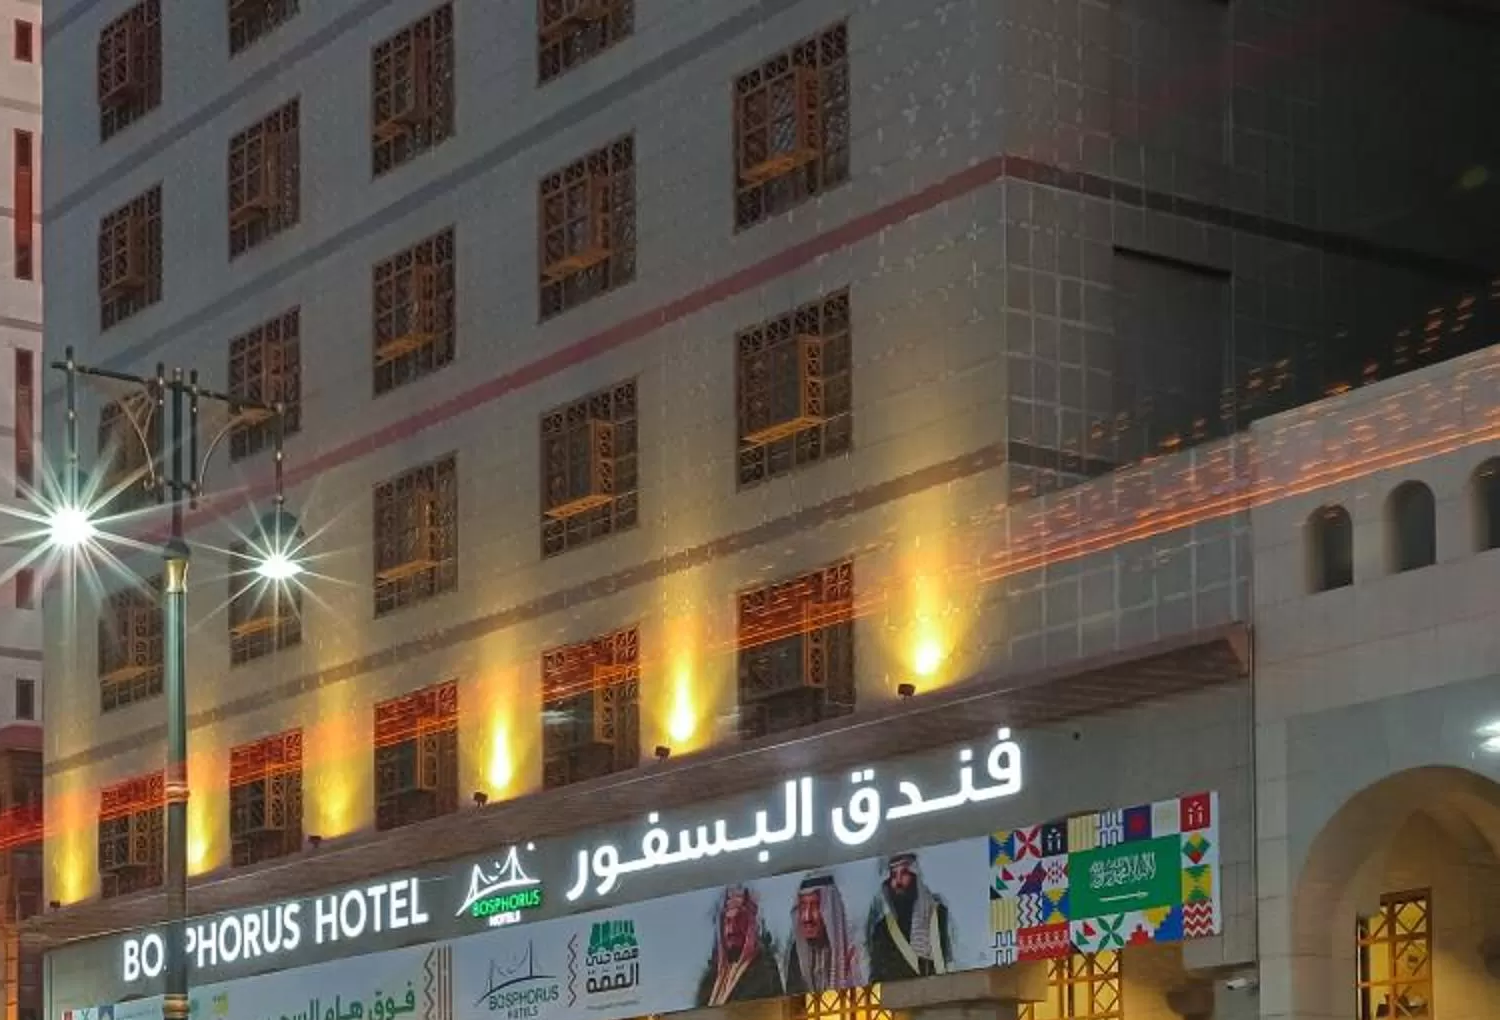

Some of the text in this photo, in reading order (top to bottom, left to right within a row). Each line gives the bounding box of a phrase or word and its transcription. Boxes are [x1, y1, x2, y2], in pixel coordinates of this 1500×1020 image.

[565, 727, 1023, 901] فندق البسفور
[313, 876, 430, 945] HOTEL
[472, 889, 541, 917] BOSPHORUS
[489, 984, 560, 1011] BOSPHORUS
